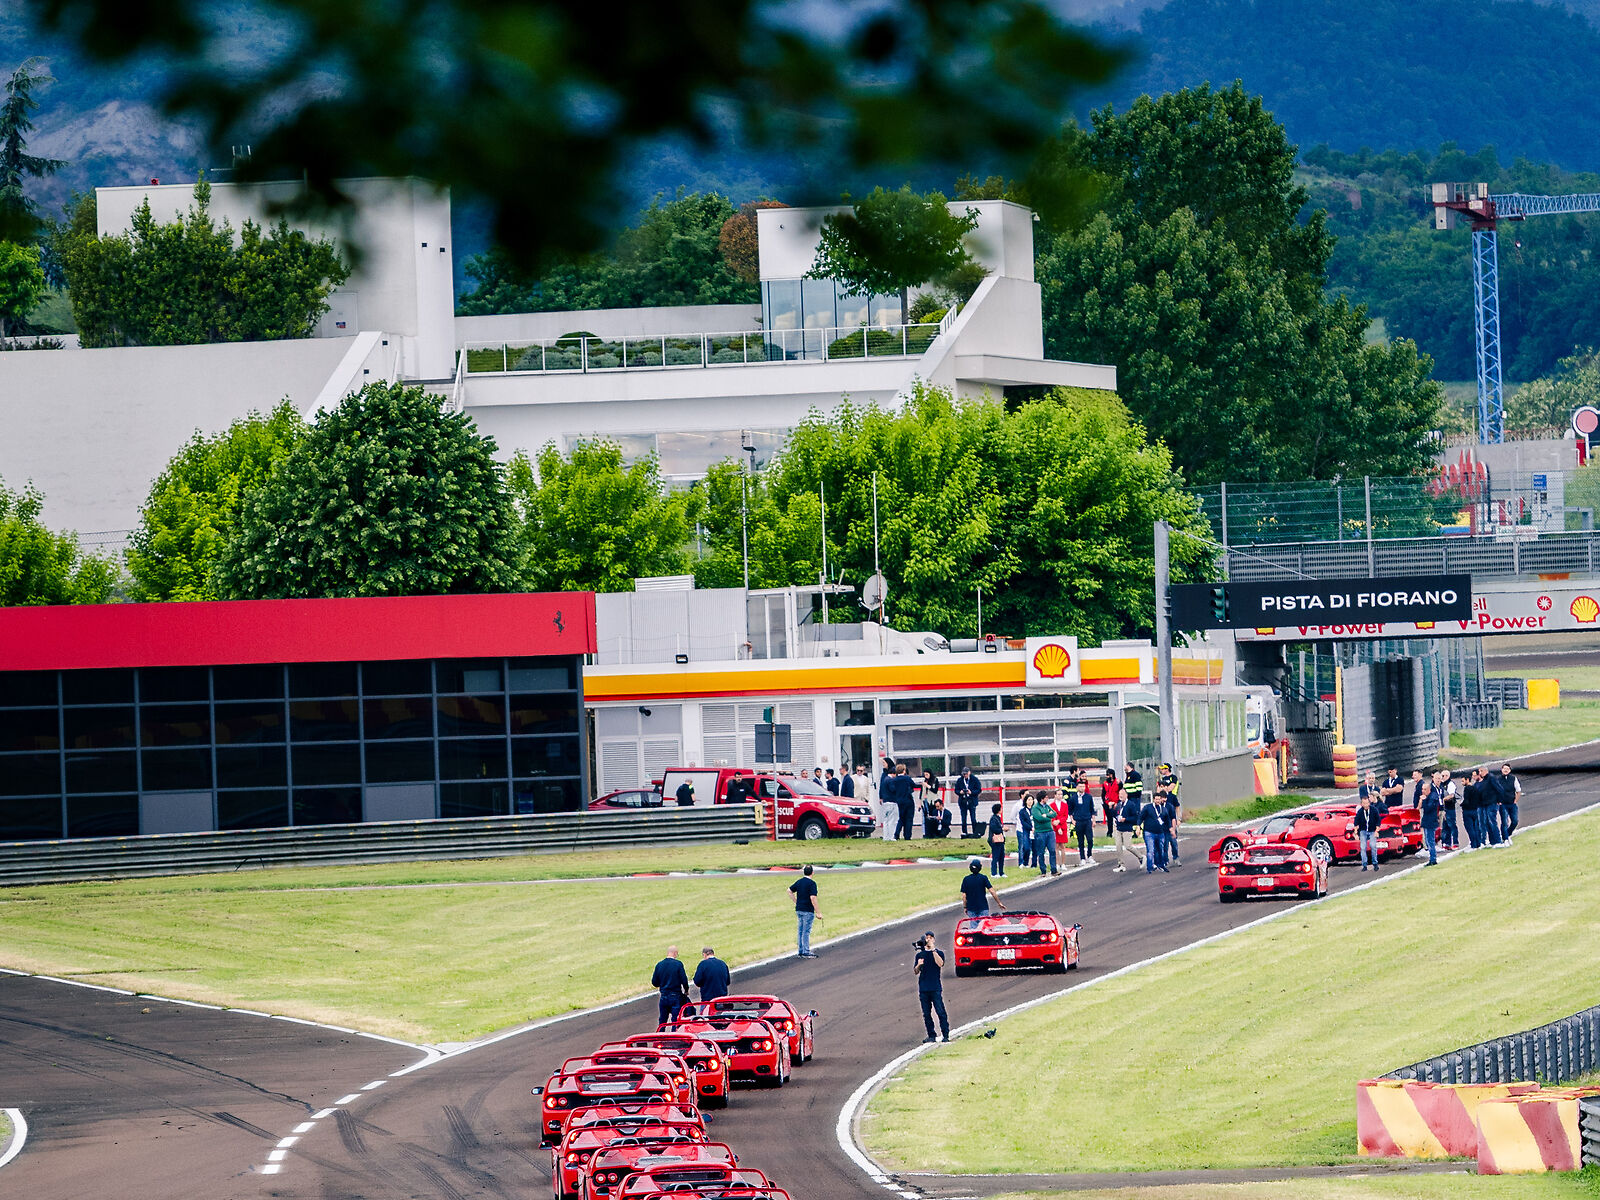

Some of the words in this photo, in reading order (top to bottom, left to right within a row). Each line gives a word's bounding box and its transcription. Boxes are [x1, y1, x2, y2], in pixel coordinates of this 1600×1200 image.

[1261, 595, 1325, 611] PISTA
[1329, 593, 1351, 609] DI
[1357, 590, 1458, 608] FIORANO
[1473, 598, 1487, 610] ell
[1458, 613, 1547, 630] V-Power
